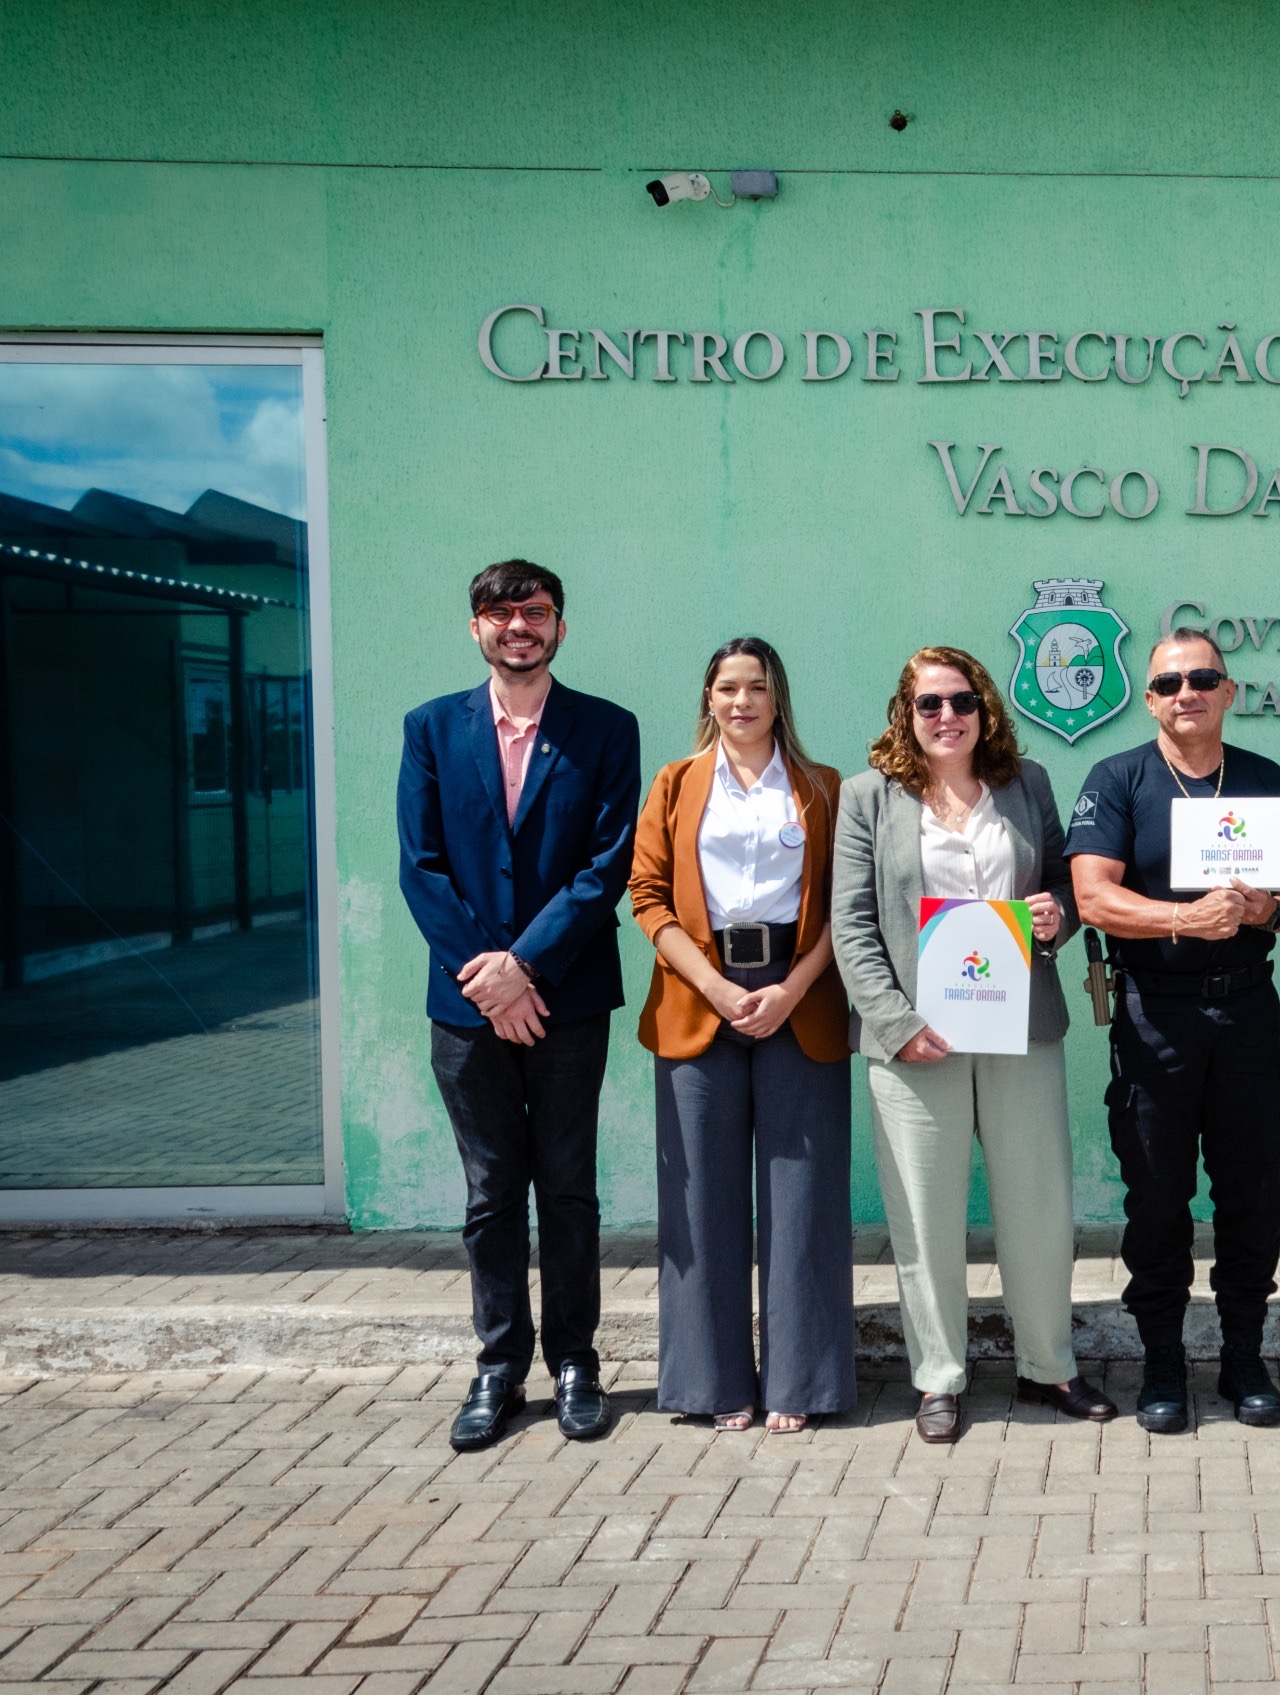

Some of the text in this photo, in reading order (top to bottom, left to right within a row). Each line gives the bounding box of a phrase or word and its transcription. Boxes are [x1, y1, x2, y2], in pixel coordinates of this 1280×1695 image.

[477, 304, 787, 383] CENTRO
[802, 330, 901, 382] DE
[927, 440, 1160, 519] VASCO
[1200, 849, 1263, 861] TRANSFORMAR
[944, 988, 1007, 1002] TRANSFORMAR
